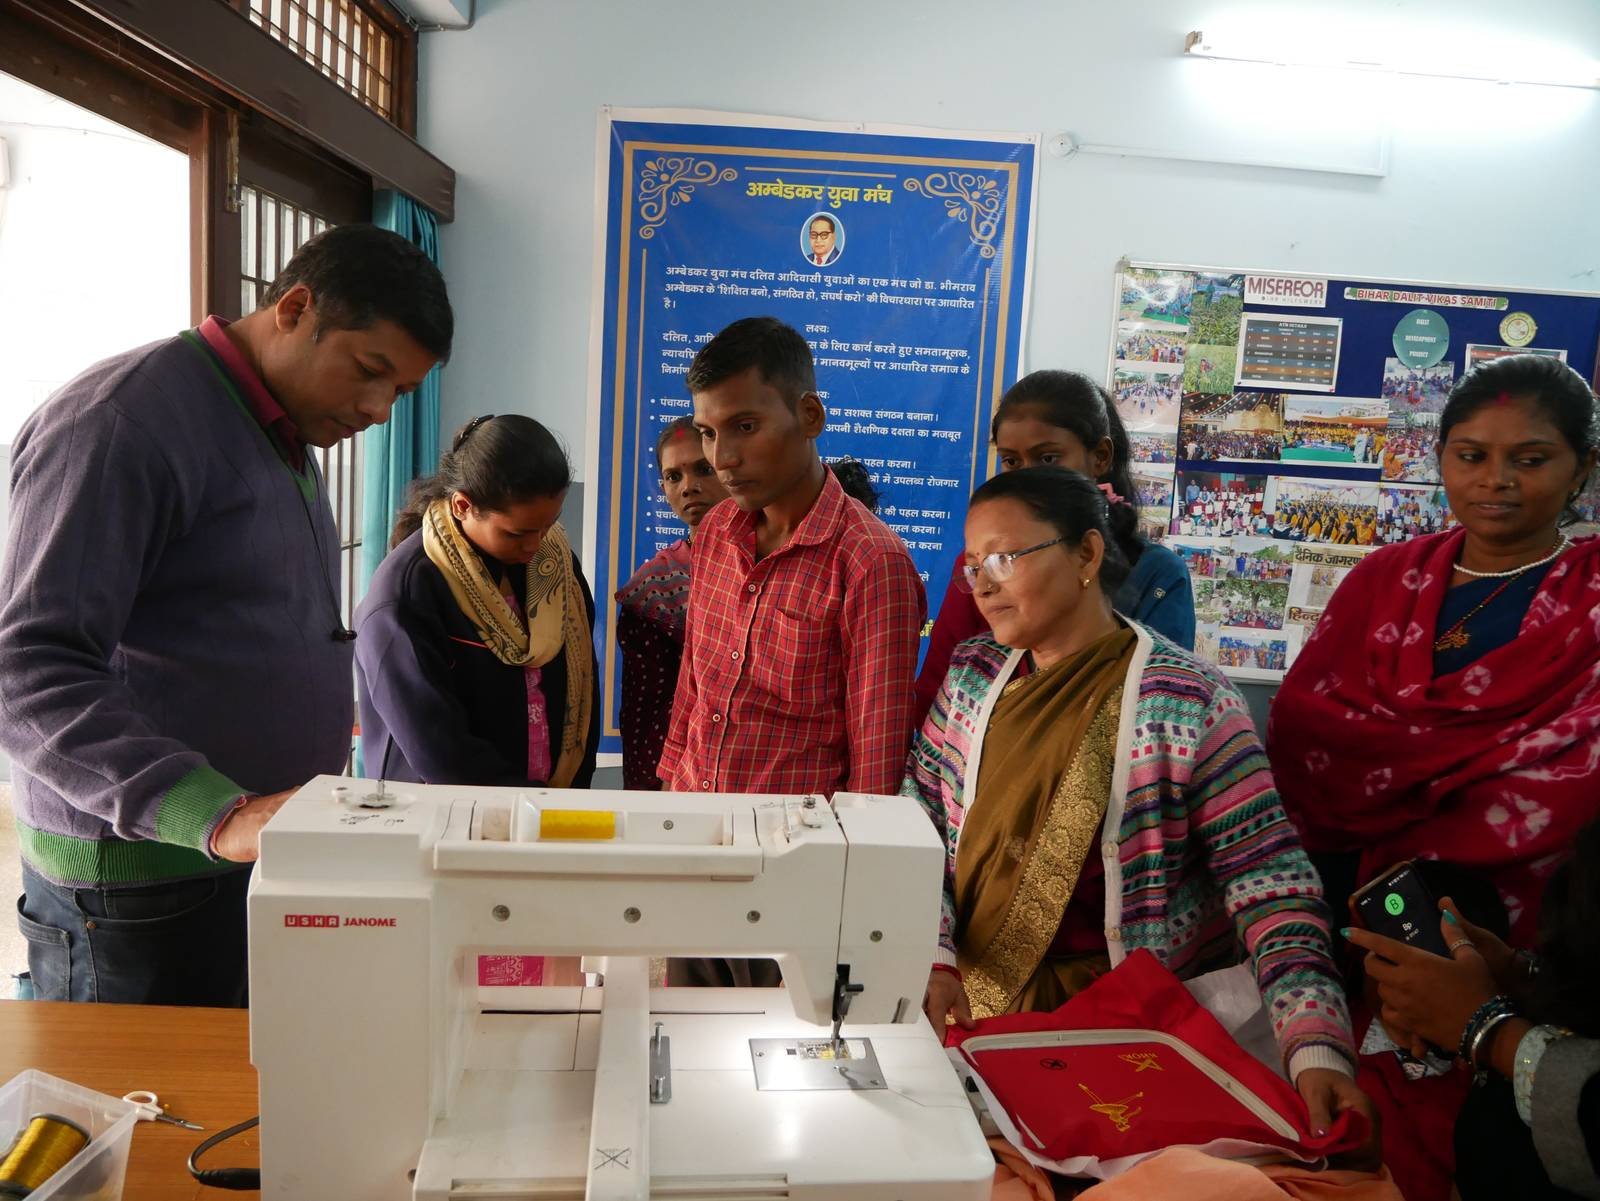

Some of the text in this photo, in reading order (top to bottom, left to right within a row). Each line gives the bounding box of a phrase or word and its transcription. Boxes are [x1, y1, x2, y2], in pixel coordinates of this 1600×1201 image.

[746, 178, 893, 208] अम्बेडकर युवा मंच
[666, 265, 708, 278] अम्बेडकर
[710, 268, 728, 281] युवा
[750, 269, 774, 280] दलित
[778, 272, 820, 283] आदिवासी
[824, 272, 854, 287] युवाओं
[858, 277, 870, 286] का
[872, 278, 888, 287] एक
[910, 278, 922, 289] जो
[940, 280, 976, 292] भीमराव
[665, 281, 704, 294] अम्बेडकर
[706, 283, 715, 294] के
[806, 288, 818, 300] हो,
[866, 292, 878, 304] की
[880, 293, 922, 306] विचारधारा
[924, 298, 936, 307] पर
[938, 297, 975, 309] आधारित
[1248, 278, 1324, 298] MISEREOR
[1358, 290, 1390, 300] BIHAR
[1461, 295, 1496, 307] SAMITI
[662, 330, 691, 344] दलित,
[820, 339, 828, 350] के
[831, 340, 850, 352] लिए
[852, 341, 872, 352] कार्य
[874, 342, 896, 354] करते
[898, 345, 912, 358] हुए
[914, 346, 970, 360] समतामूलक,
[820, 358, 870, 371] मानवमूल्यों
[874, 362, 886, 370] पर
[888, 360, 928, 373] आधारित
[930, 364, 958, 374] समाज
[960, 363, 970, 374] के
[660, 396, 690, 408] पंचायत
[830, 408, 841, 416] का
[844, 410, 872, 419] सशक्त
[876, 408, 904, 420] संगठन
[825, 422, 850, 432] अपनी
[854, 424, 889, 436] शैक्षणिक
[891, 427, 914, 437] दक्षता
[932, 430, 961, 442] मजबूत
[864, 458, 884, 468] पहल
[882, 473, 890, 484] में
[927, 476, 960, 488] रोजगार
[656, 509, 680, 520] पंचाय
[884, 506, 896, 516] की
[898, 508, 919, 518] पहल
[918, 541, 942, 550] करना
[1295, 546, 1324, 562] दैनिक
[1389, 899, 1400, 910] B
[285, 915, 397, 928] USHA JANOME
